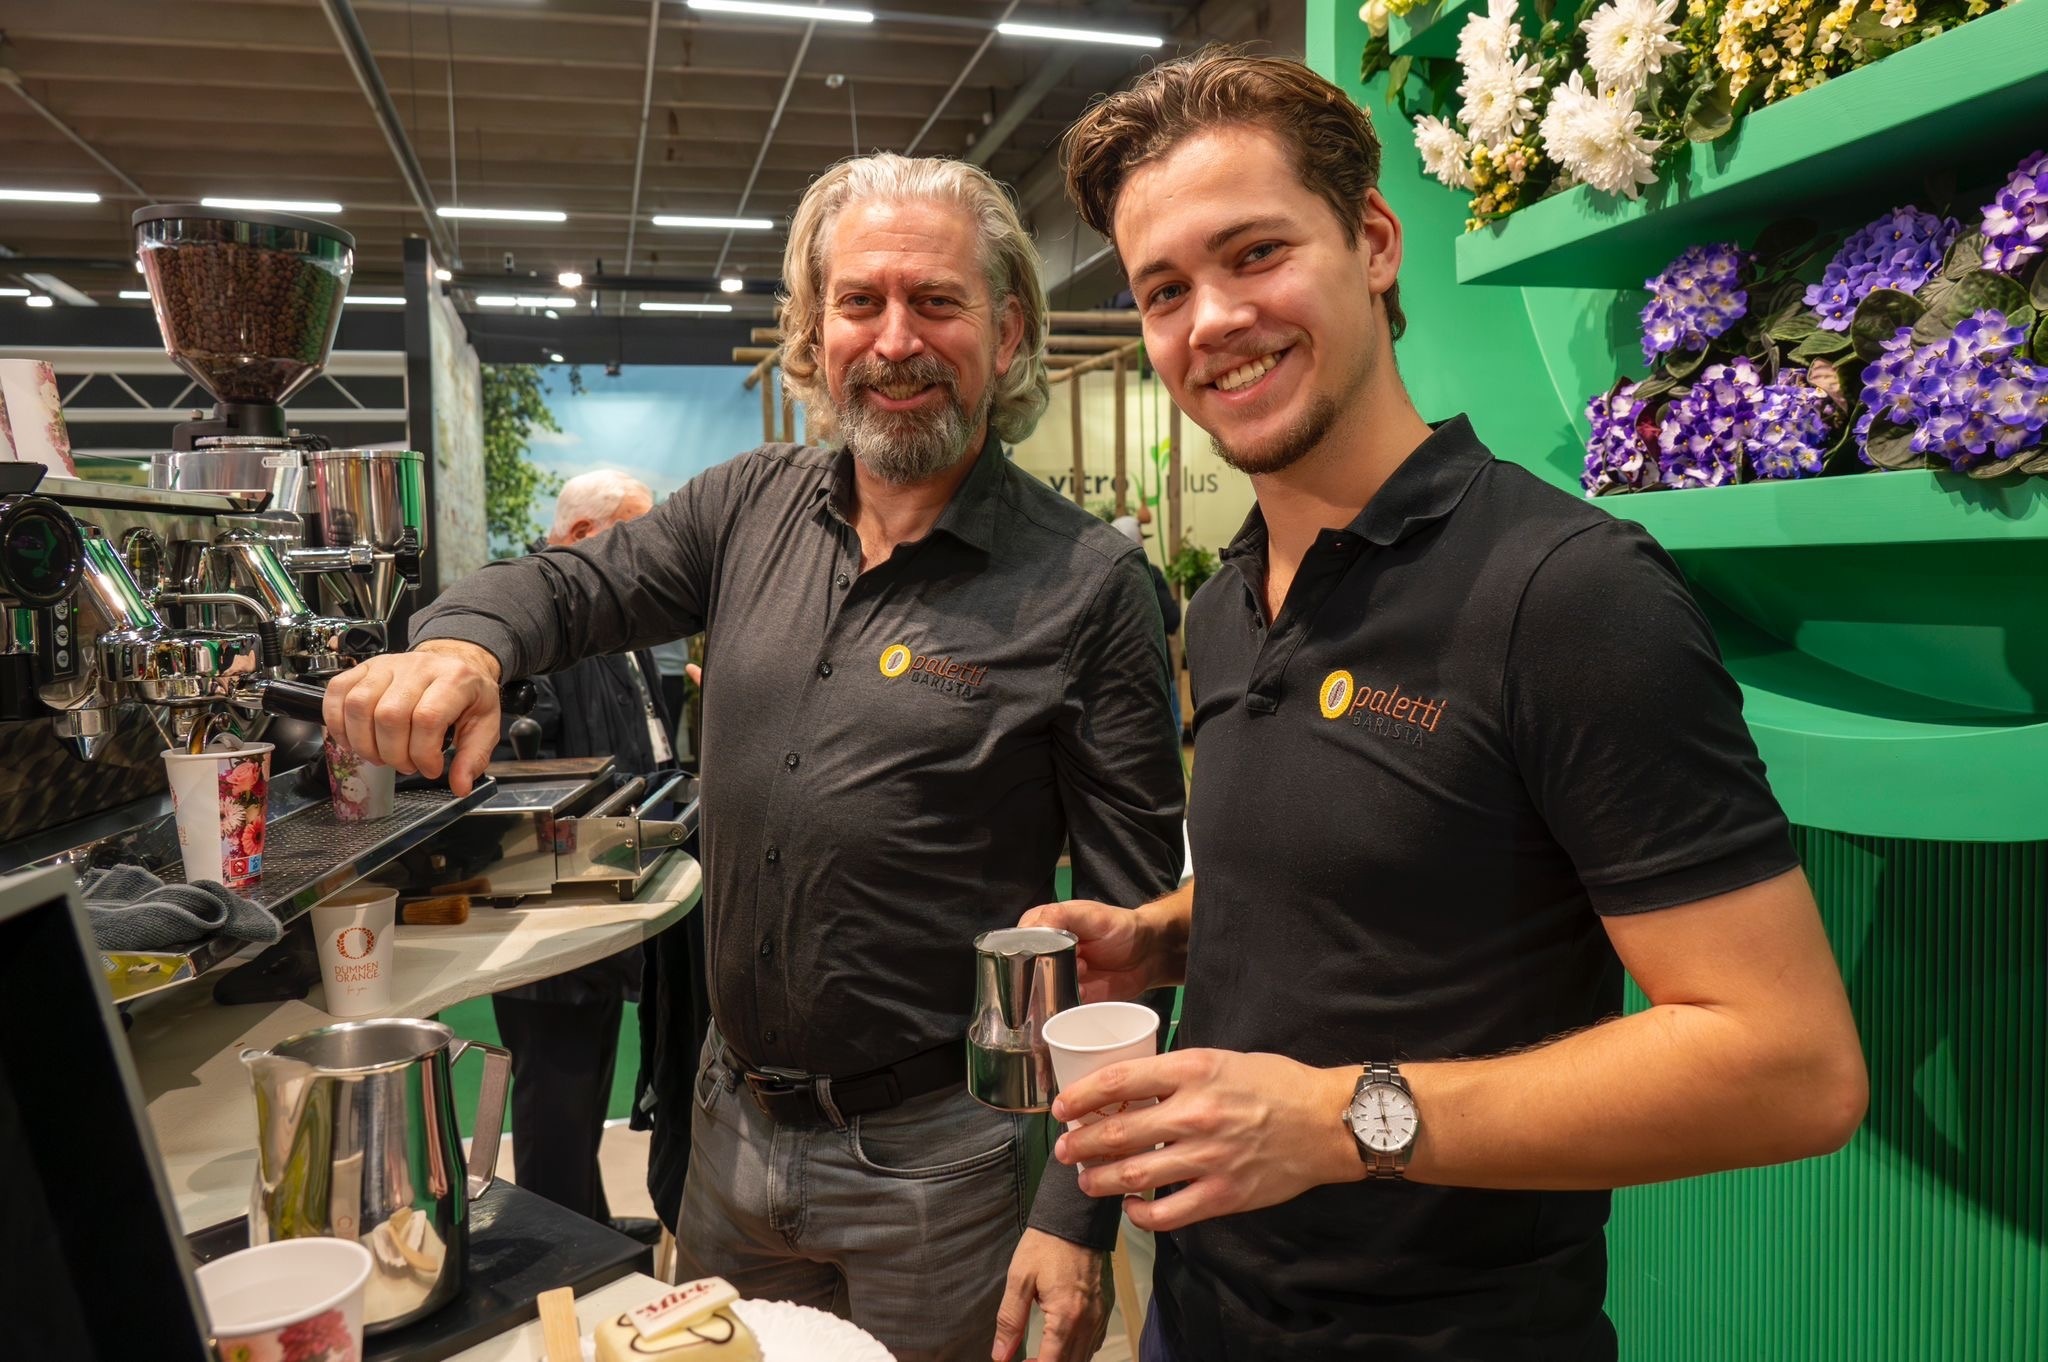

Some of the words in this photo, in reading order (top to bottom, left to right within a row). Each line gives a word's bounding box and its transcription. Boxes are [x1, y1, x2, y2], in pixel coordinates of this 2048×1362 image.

[1166, 466, 1218, 500] lus
[907, 655, 988, 686] paletti
[911, 672, 972, 697] BARISTA
[1348, 684, 1447, 732] paletti
[1353, 710, 1423, 747] BARISTA
[335, 968, 380, 983] ORANGE
